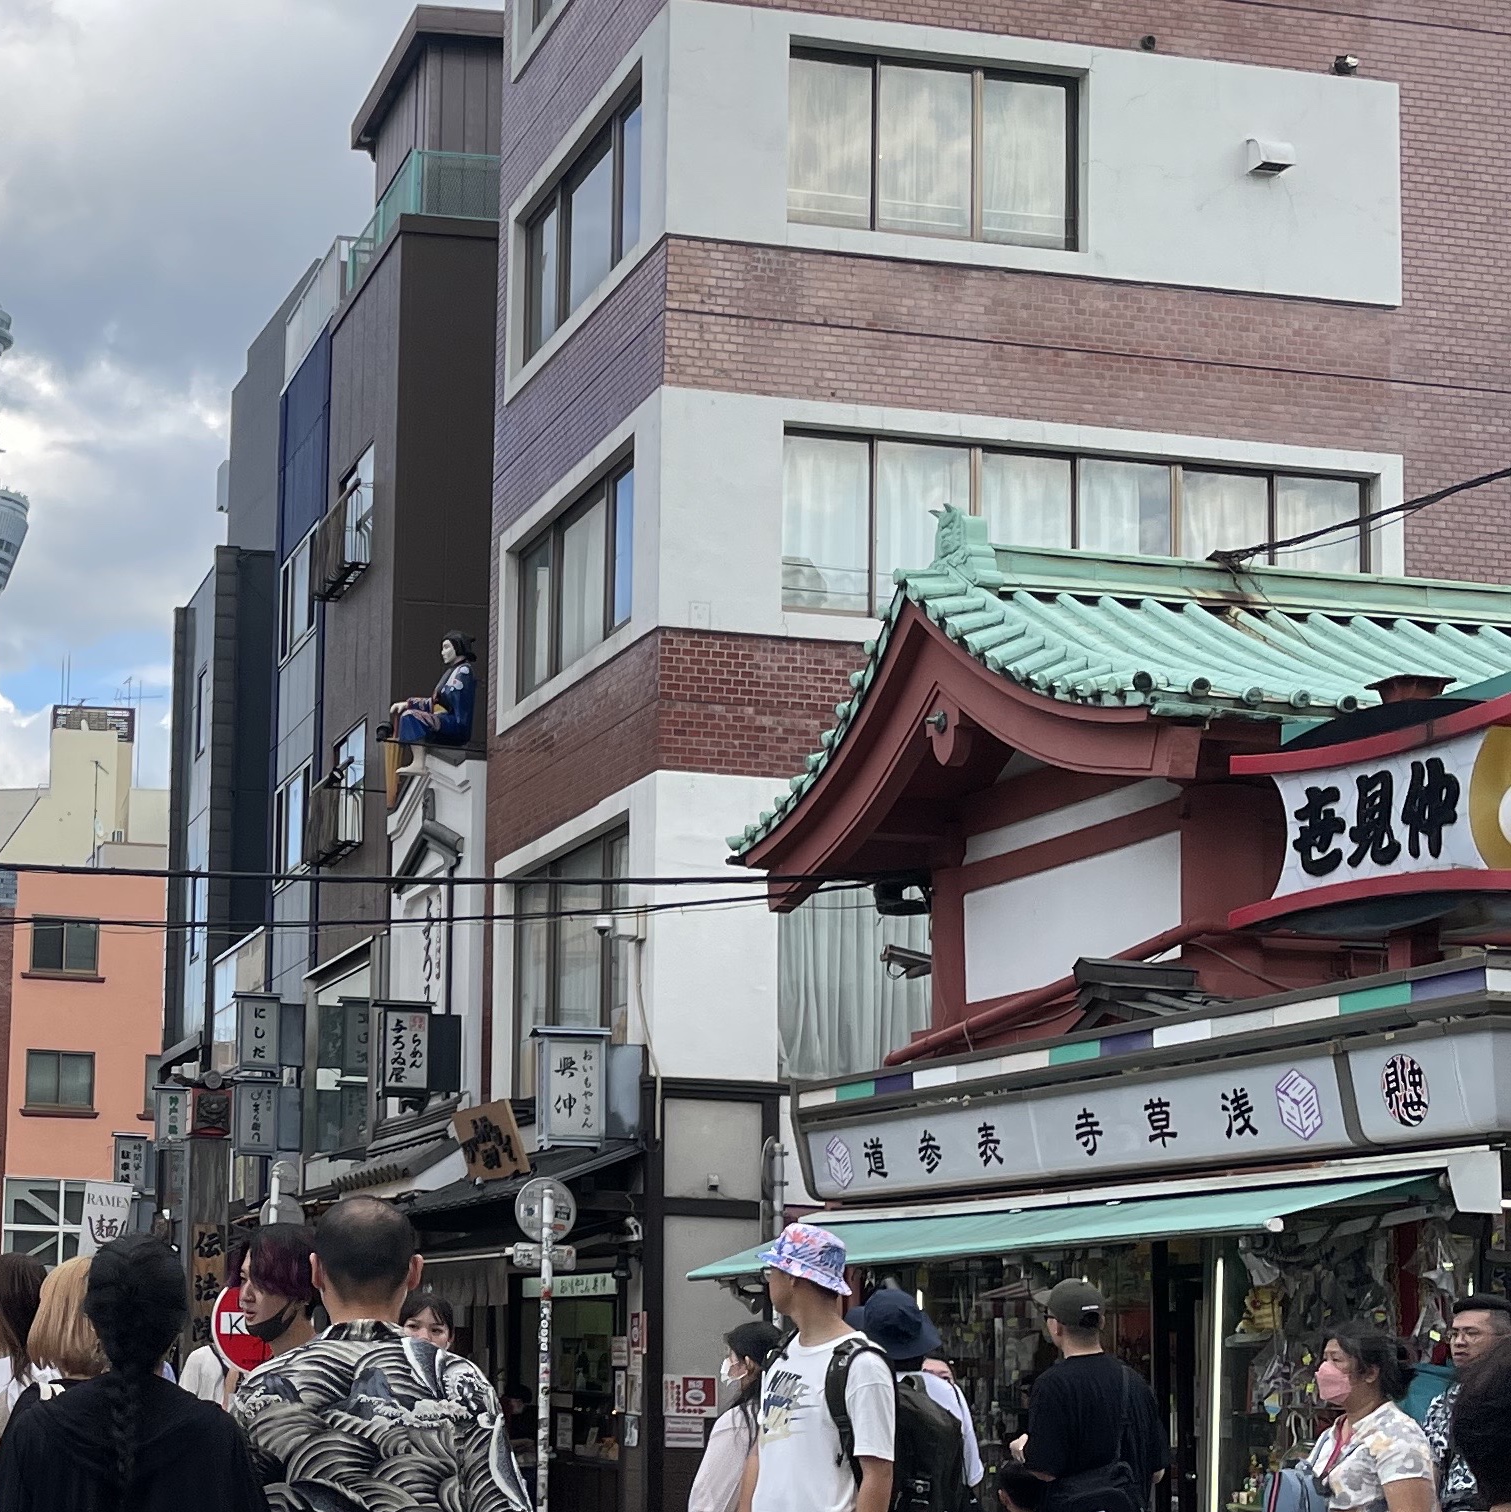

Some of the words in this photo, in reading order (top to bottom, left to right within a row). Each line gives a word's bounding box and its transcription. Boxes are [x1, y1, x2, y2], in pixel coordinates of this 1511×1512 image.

[252, 1007, 267, 1059] にしだ
[388, 1018, 408, 1083] 与ろゐ屋
[409, 1033, 423, 1069] らめん
[554, 1056, 579, 1118] 興伸
[582, 1050, 594, 1129] おいもやさん
[87, 1193, 130, 1208] RAMEN
[95, 1214, 118, 1238] 麺
